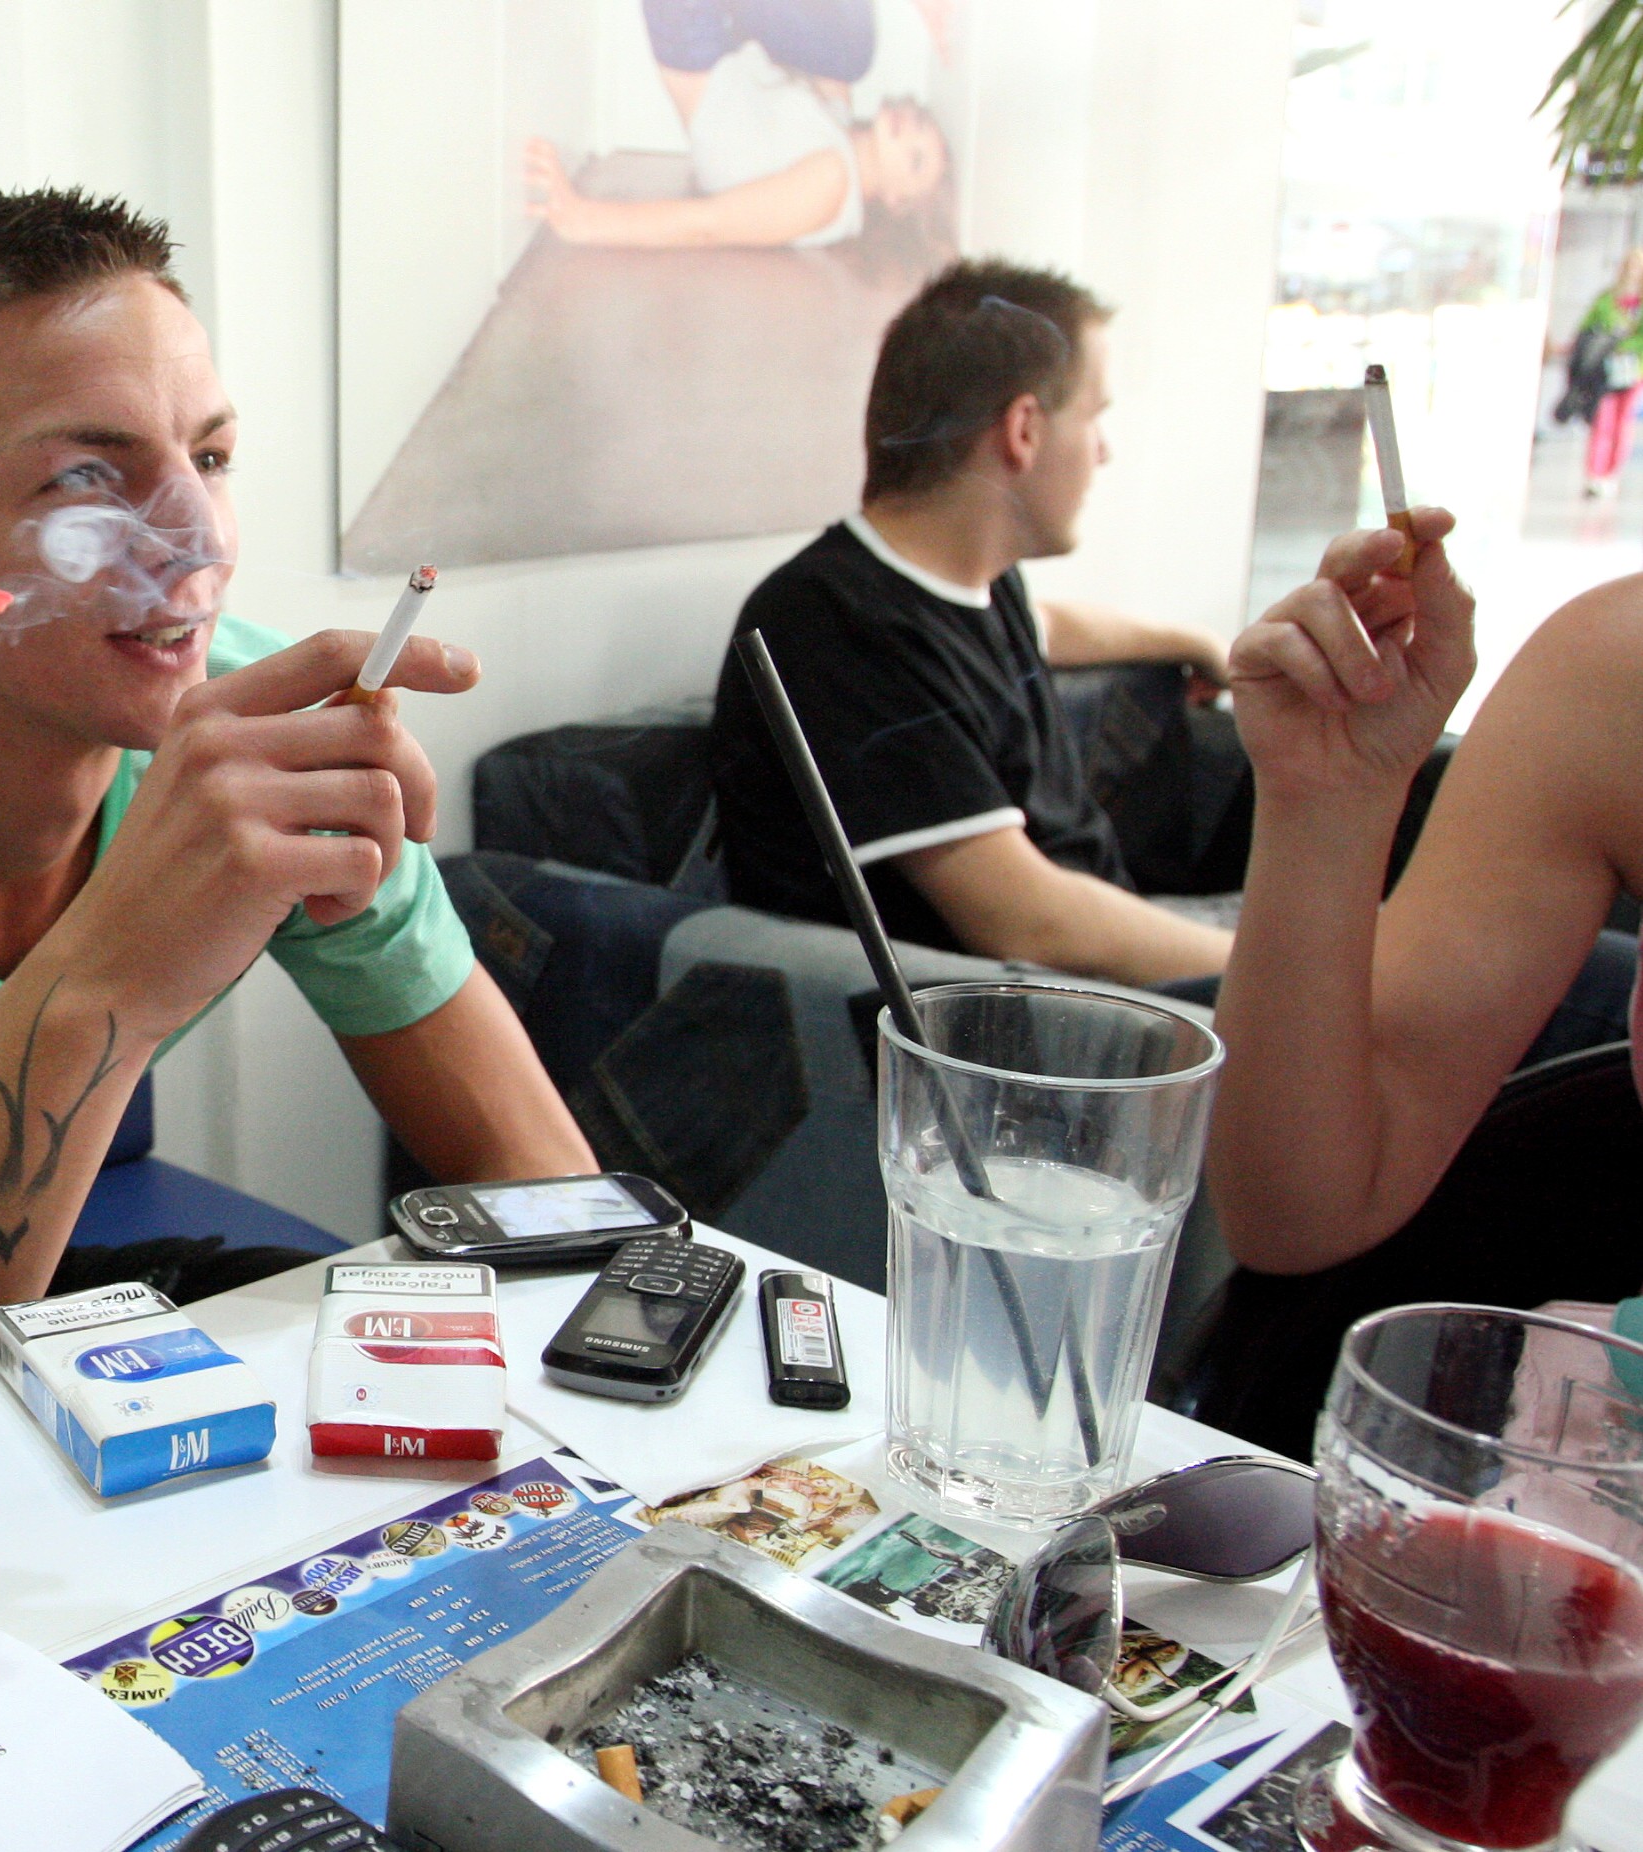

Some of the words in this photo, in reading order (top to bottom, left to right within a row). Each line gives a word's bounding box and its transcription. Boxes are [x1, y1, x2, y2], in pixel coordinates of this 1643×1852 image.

[363, 1279, 451, 1290] Fajčenie
[364, 1316, 411, 1337] L&M
[583, 1336, 650, 1353] SAMSUNG
[90, 1348, 151, 1378] L&M
[169, 1428, 210, 1471] L&M
[384, 1433, 425, 1456] L&M
[391, 1522, 432, 1554] CHIVAS
[159, 1622, 250, 1675] BECH
